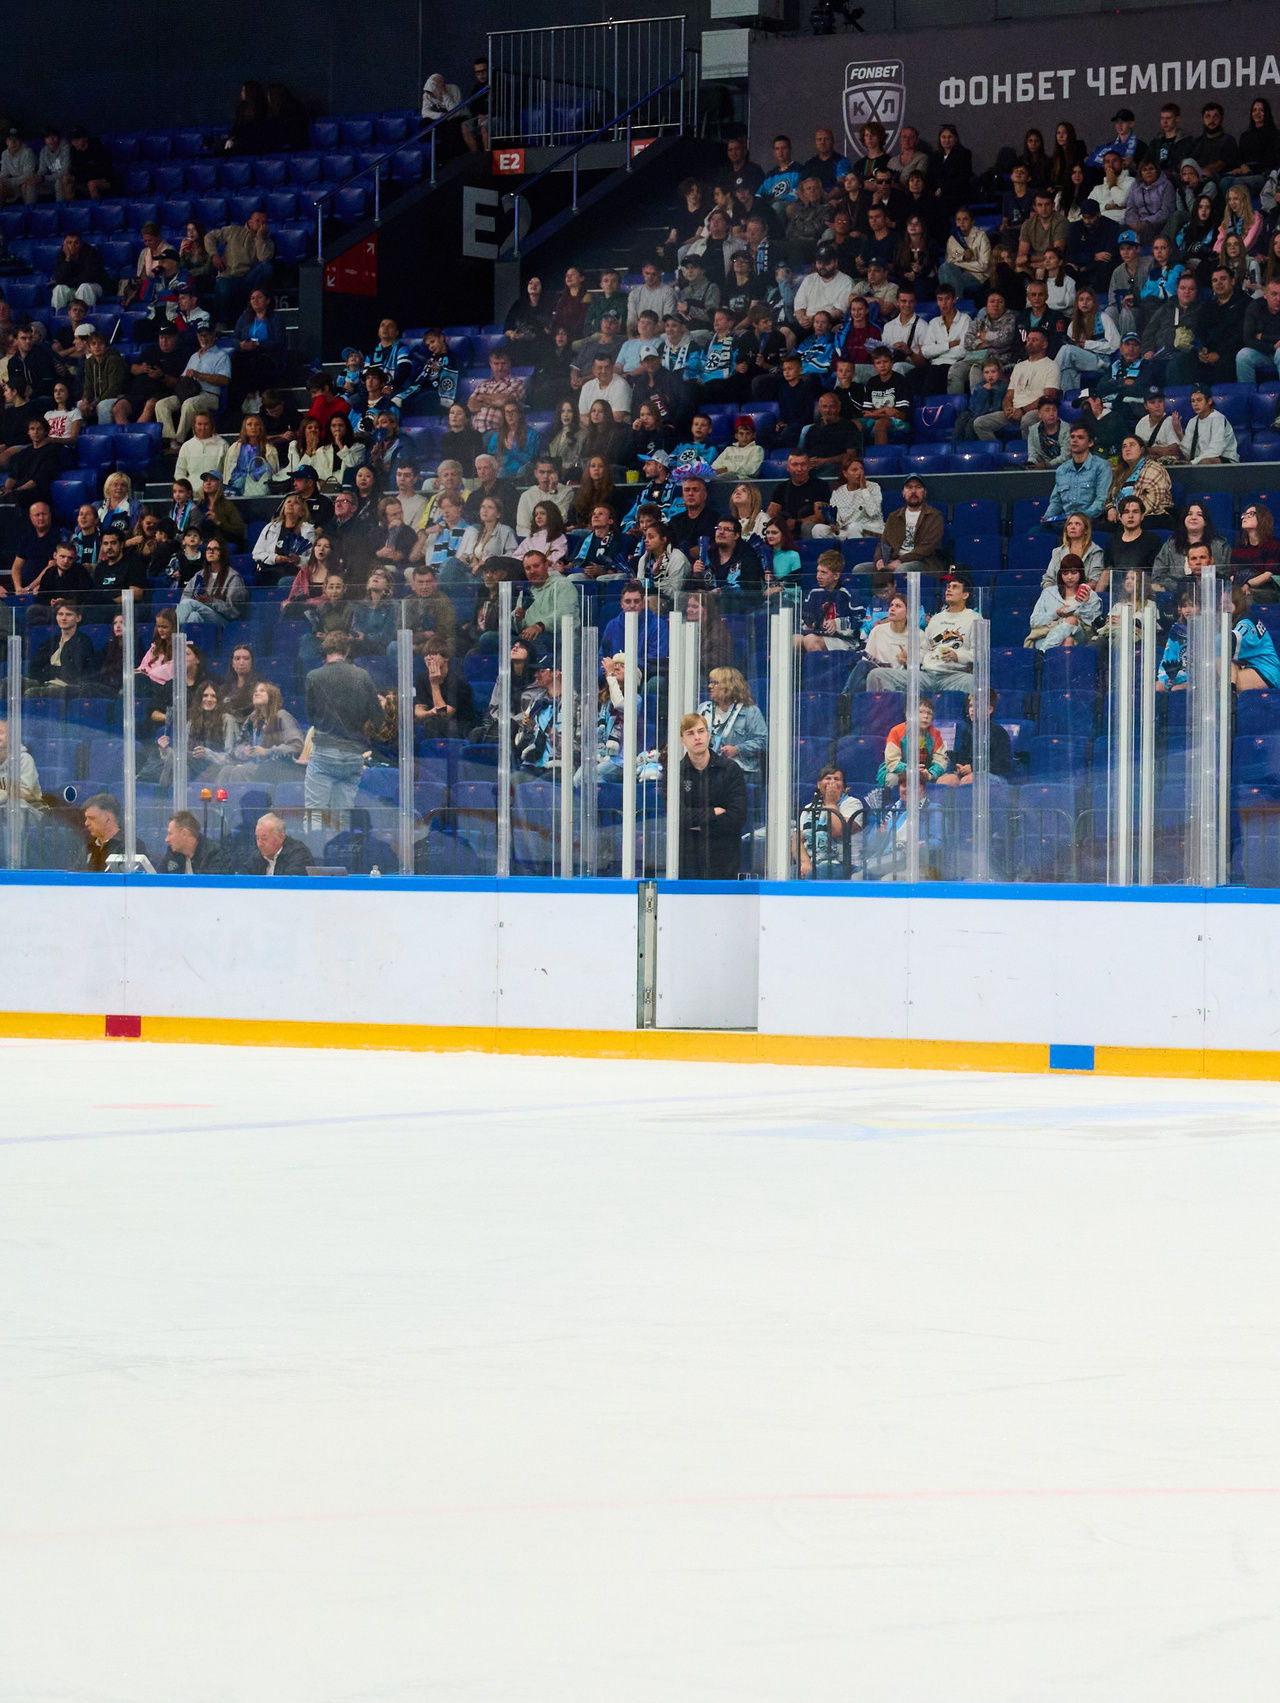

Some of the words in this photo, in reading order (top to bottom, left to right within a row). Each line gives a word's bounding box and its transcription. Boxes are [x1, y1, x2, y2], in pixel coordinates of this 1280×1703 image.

[850, 64, 899, 80] FONBET
[939, 69, 1076, 108] ФОНБЕТ
[853, 89, 896, 123] КХЛ
[499, 153, 520, 170] E2
[462, 185, 532, 259] E2
[273, 295, 290, 309] 16
